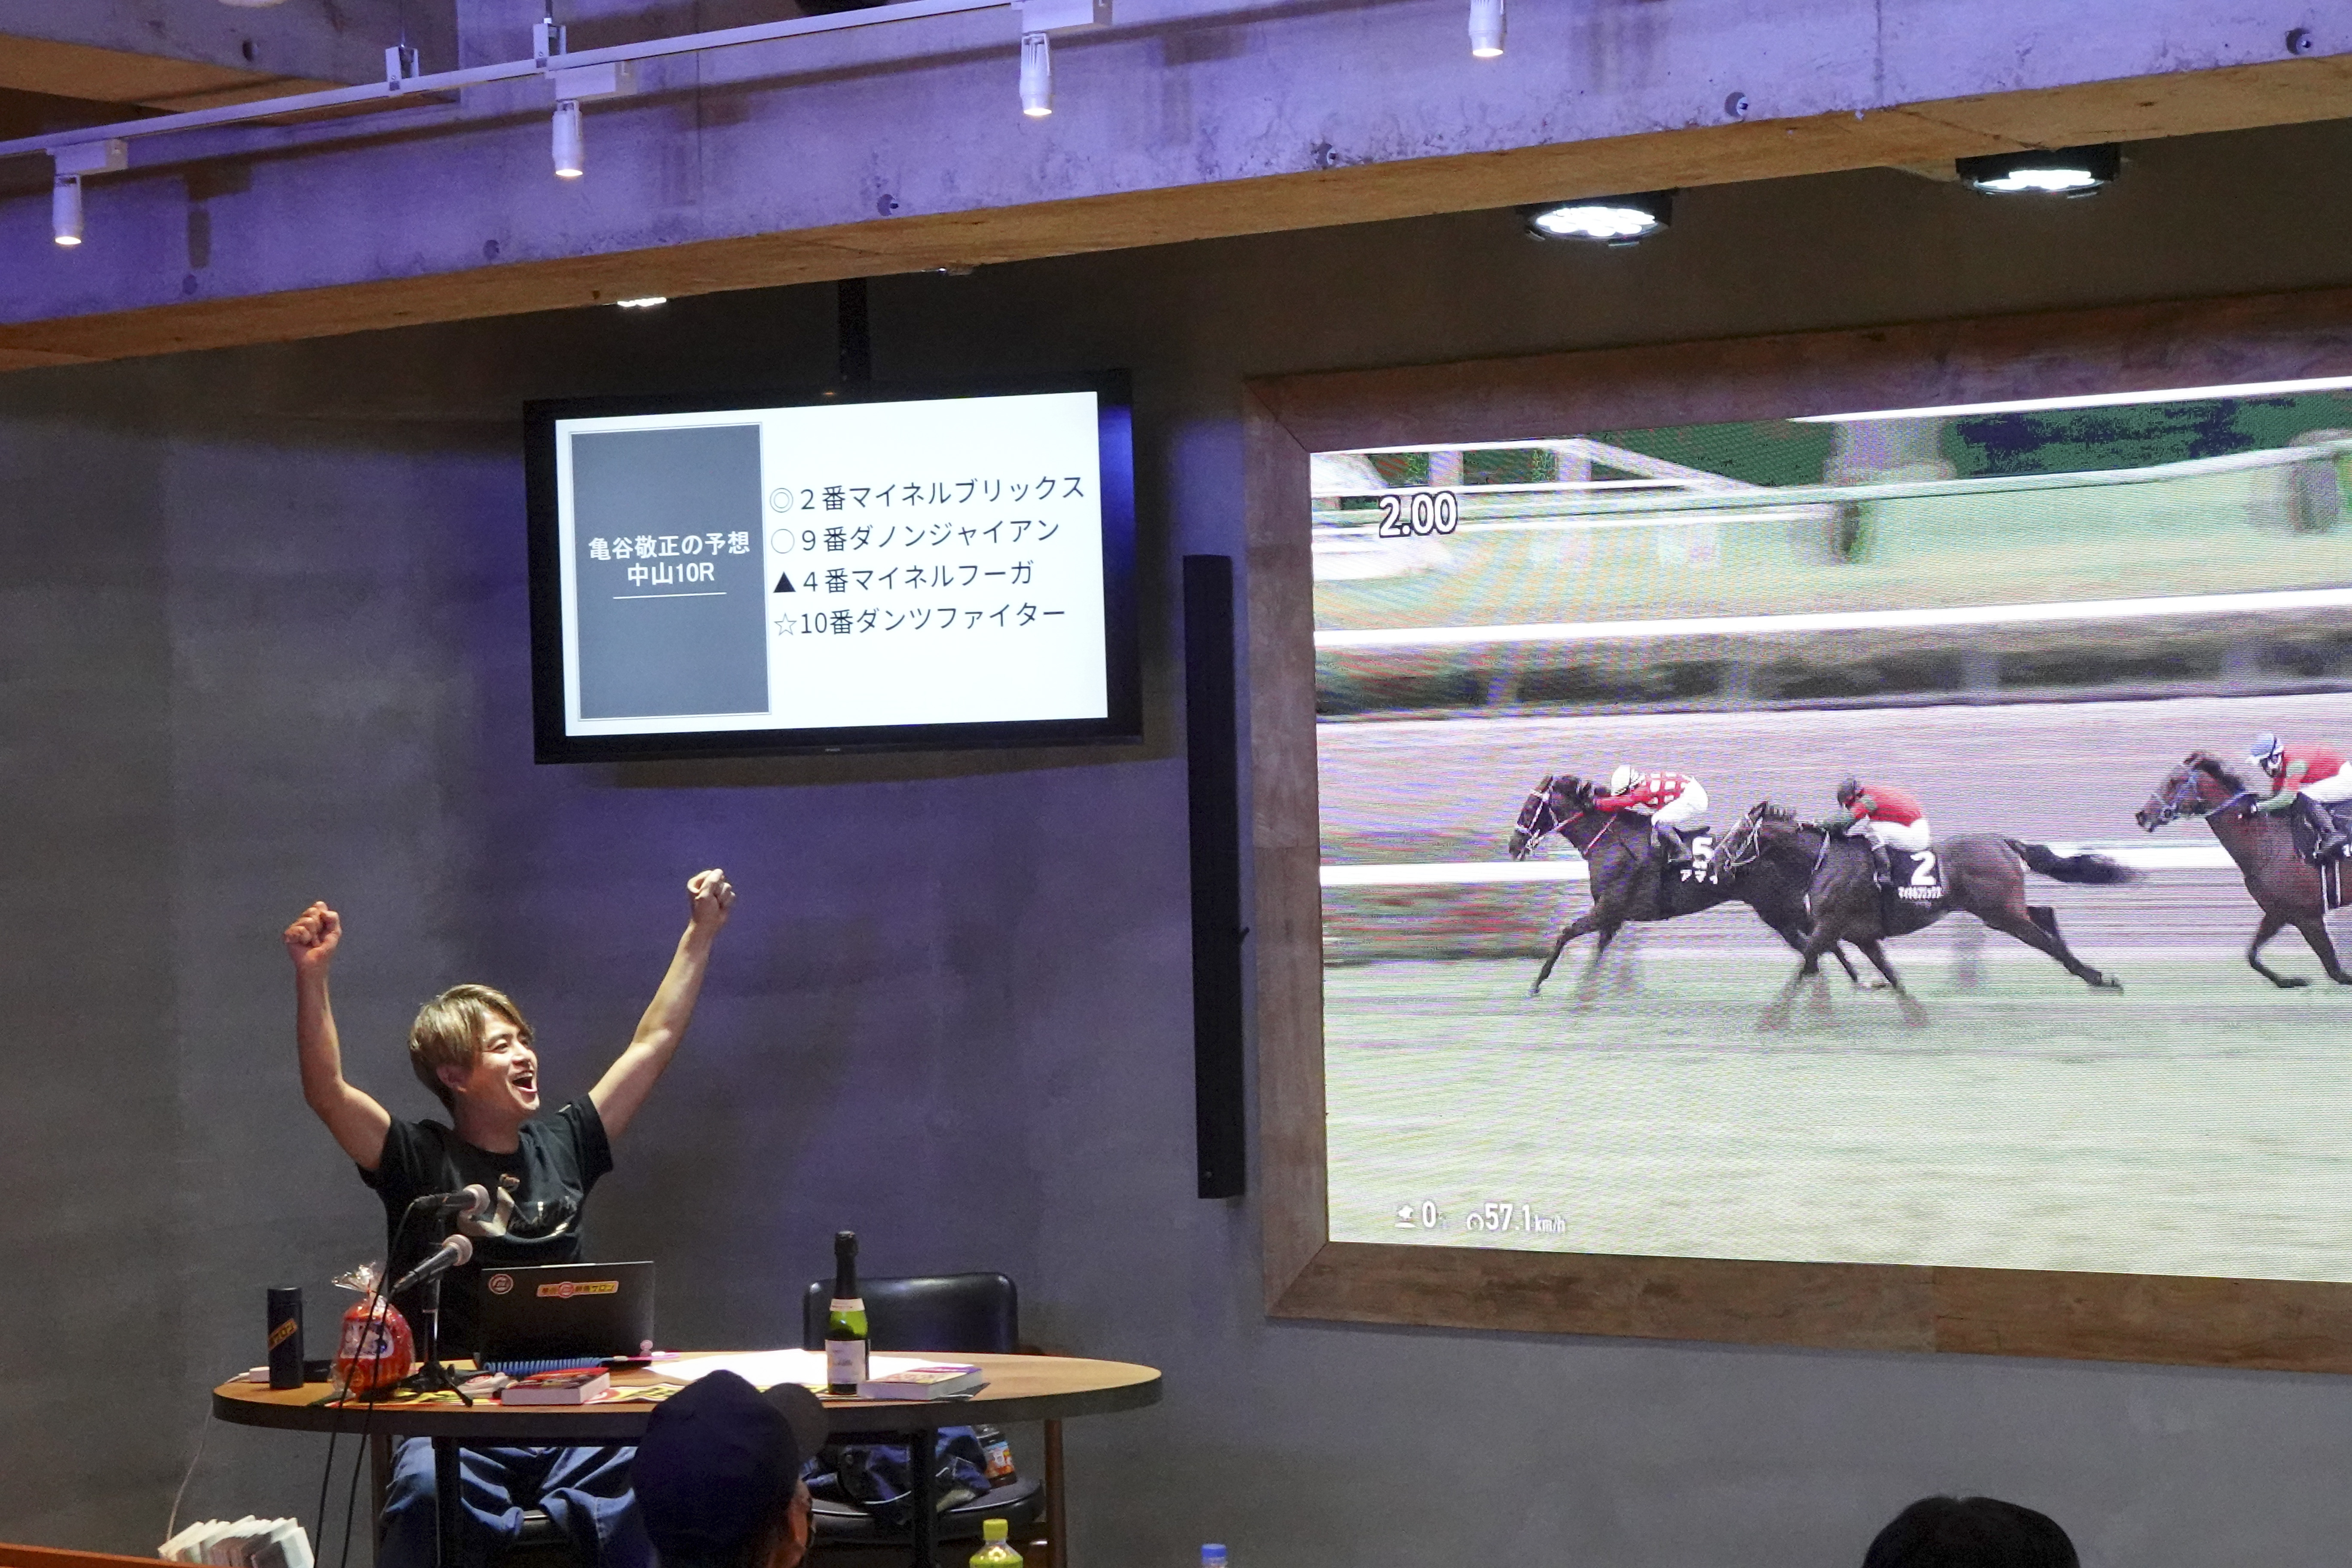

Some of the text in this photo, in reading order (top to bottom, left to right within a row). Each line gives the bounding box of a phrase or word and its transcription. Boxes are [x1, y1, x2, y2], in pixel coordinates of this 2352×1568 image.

[1379, 490, 1458, 538] 2.00
[588, 531, 750, 560] 亀谷敬正の予想
[627, 562, 715, 587] 中山10R
[1692, 836, 1716, 869] 5
[1910, 850, 1937, 885] 2
[1422, 1201, 1436, 1228] 0
